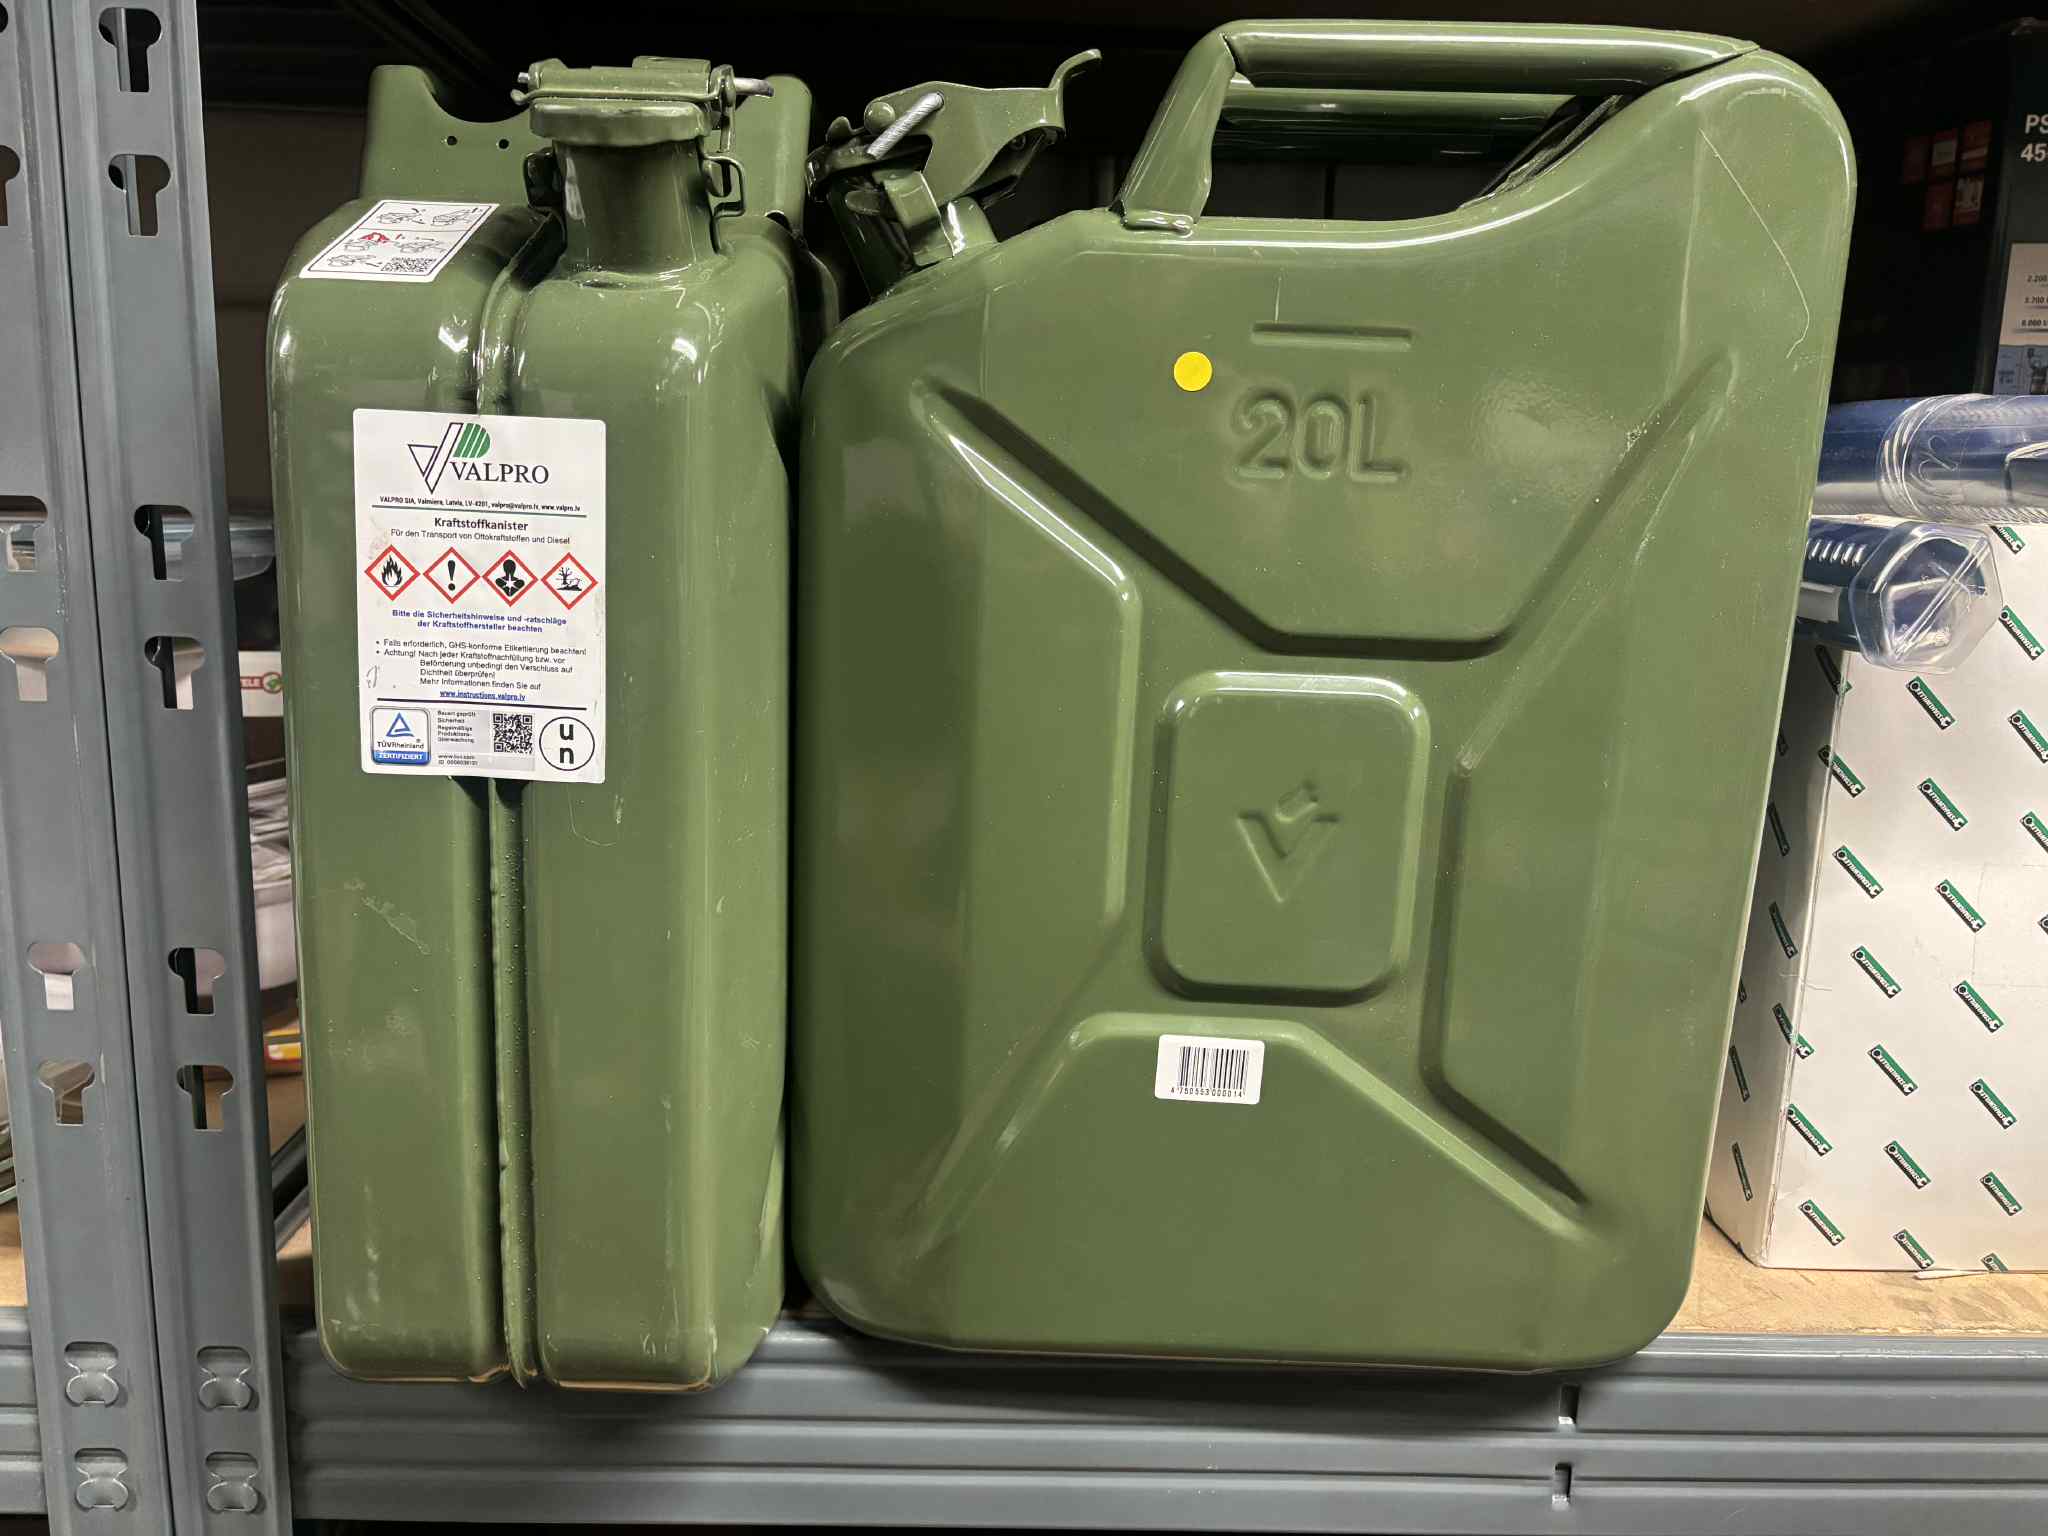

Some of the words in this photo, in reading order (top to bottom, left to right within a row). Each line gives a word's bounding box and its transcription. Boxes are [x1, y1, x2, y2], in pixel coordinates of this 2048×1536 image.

[1232, 386, 1411, 484] 20L
[449, 461, 549, 484] VALPRO
[434, 517, 528, 531] Kraftstoffkanister
[390, 528, 404, 537] Für
[405, 529, 420, 537] den
[421, 530, 457, 540] Transport
[474, 532, 530, 542] Ottokraftstoffen
[548, 536, 570, 544] Diesel
[392, 610, 410, 618] Bitte
[412, 610, 424, 618] die
[427, 610, 505, 622] Sicherheitshinweise
[507, 614, 522, 622] und
[524, 616, 567, 626] -ratschläge
[432, 620, 506, 630] Kraftstoffhersteller
[507, 624, 543, 633] beachten
[384, 638, 401, 647] Falls
[403, 640, 447, 649] erforderlich,
[448, 641, 502, 650] GHS-konforme
[504, 644, 548, 654] Etikettierung
[384, 649, 416, 658] Achtung!
[418, 650, 438, 658] Nach
[440, 651, 458, 660] jeder
[460, 652, 534, 663] Kraftstoffnachfüllung
[420, 660, 466, 669] Beförderung
[468, 662, 503, 671] unbedingt
[520, 664, 560, 673] Verschluss
[420, 668, 452, 676] Dichtheit
[454, 669, 496, 679] überprüfen!
[441, 678, 490, 686] Informationen
